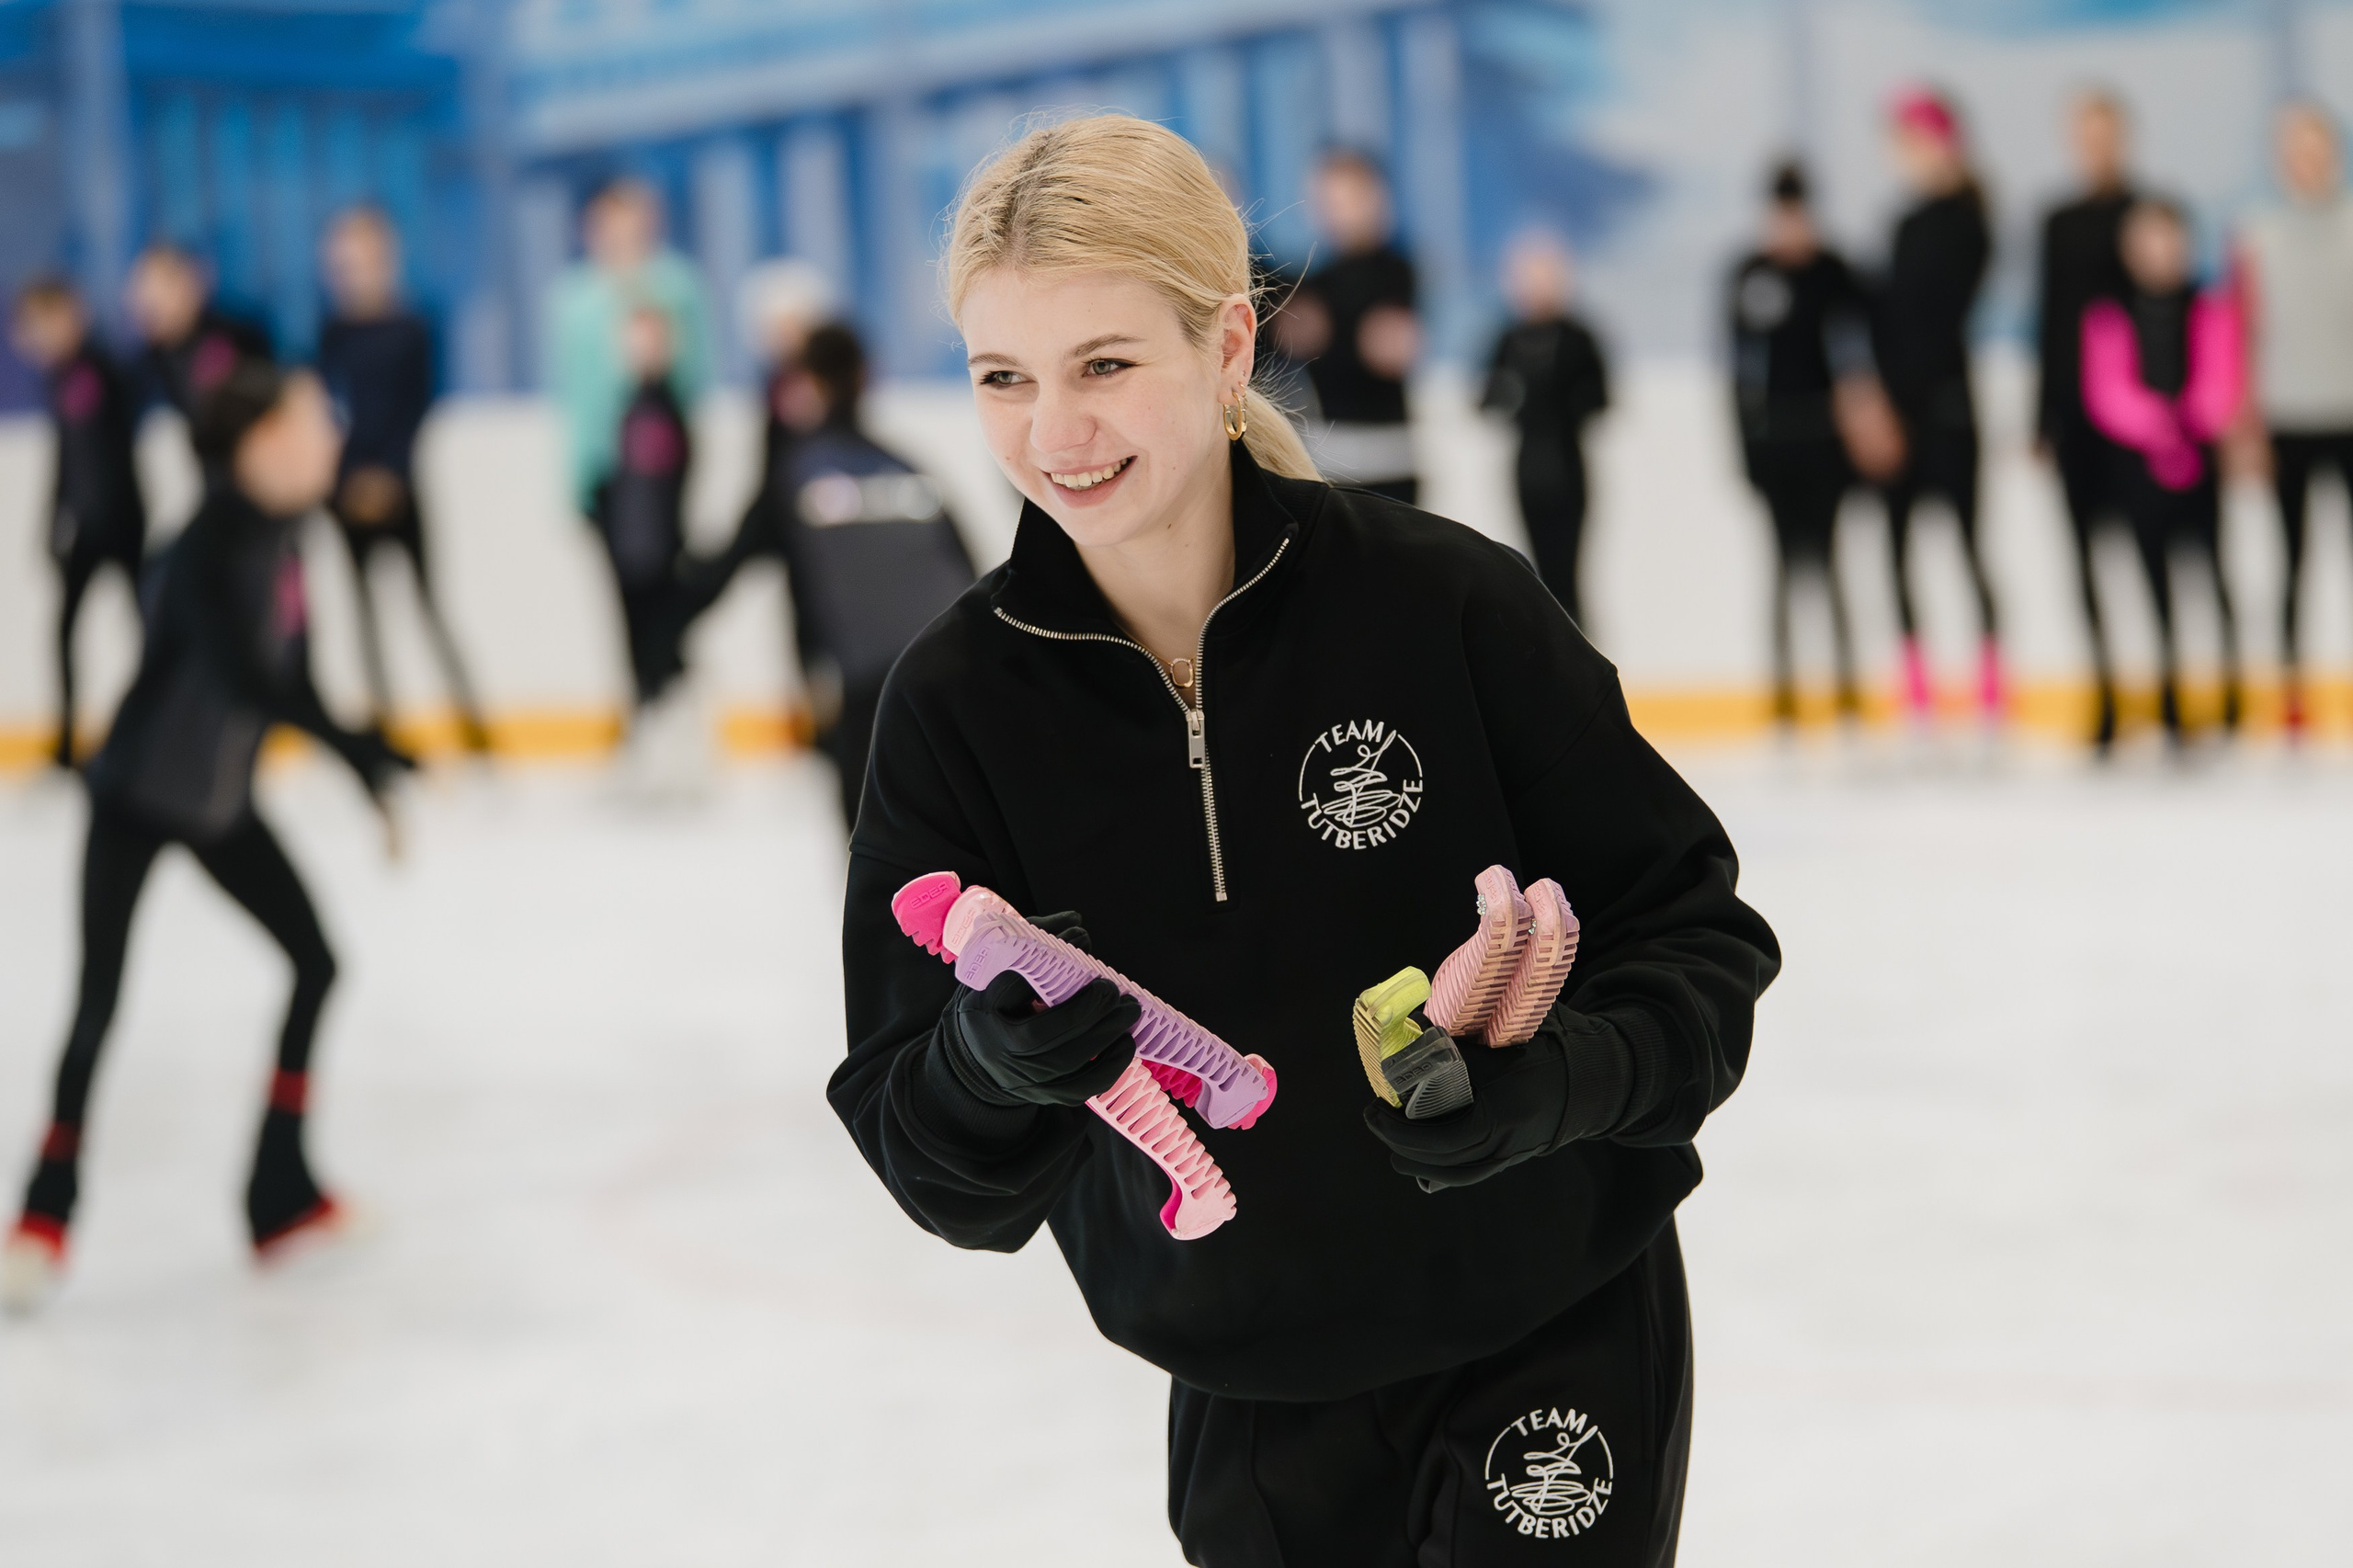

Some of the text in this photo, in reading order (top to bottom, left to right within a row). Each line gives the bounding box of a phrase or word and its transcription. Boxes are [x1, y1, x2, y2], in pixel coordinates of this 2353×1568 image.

[1314, 719, 1385, 753] TEAM
[1301, 778, 1424, 850] TUTBERIDZE
[1510, 1406, 1588, 1437] TEAM
[1486, 1472, 1613, 1540] TUTBERIDZE
